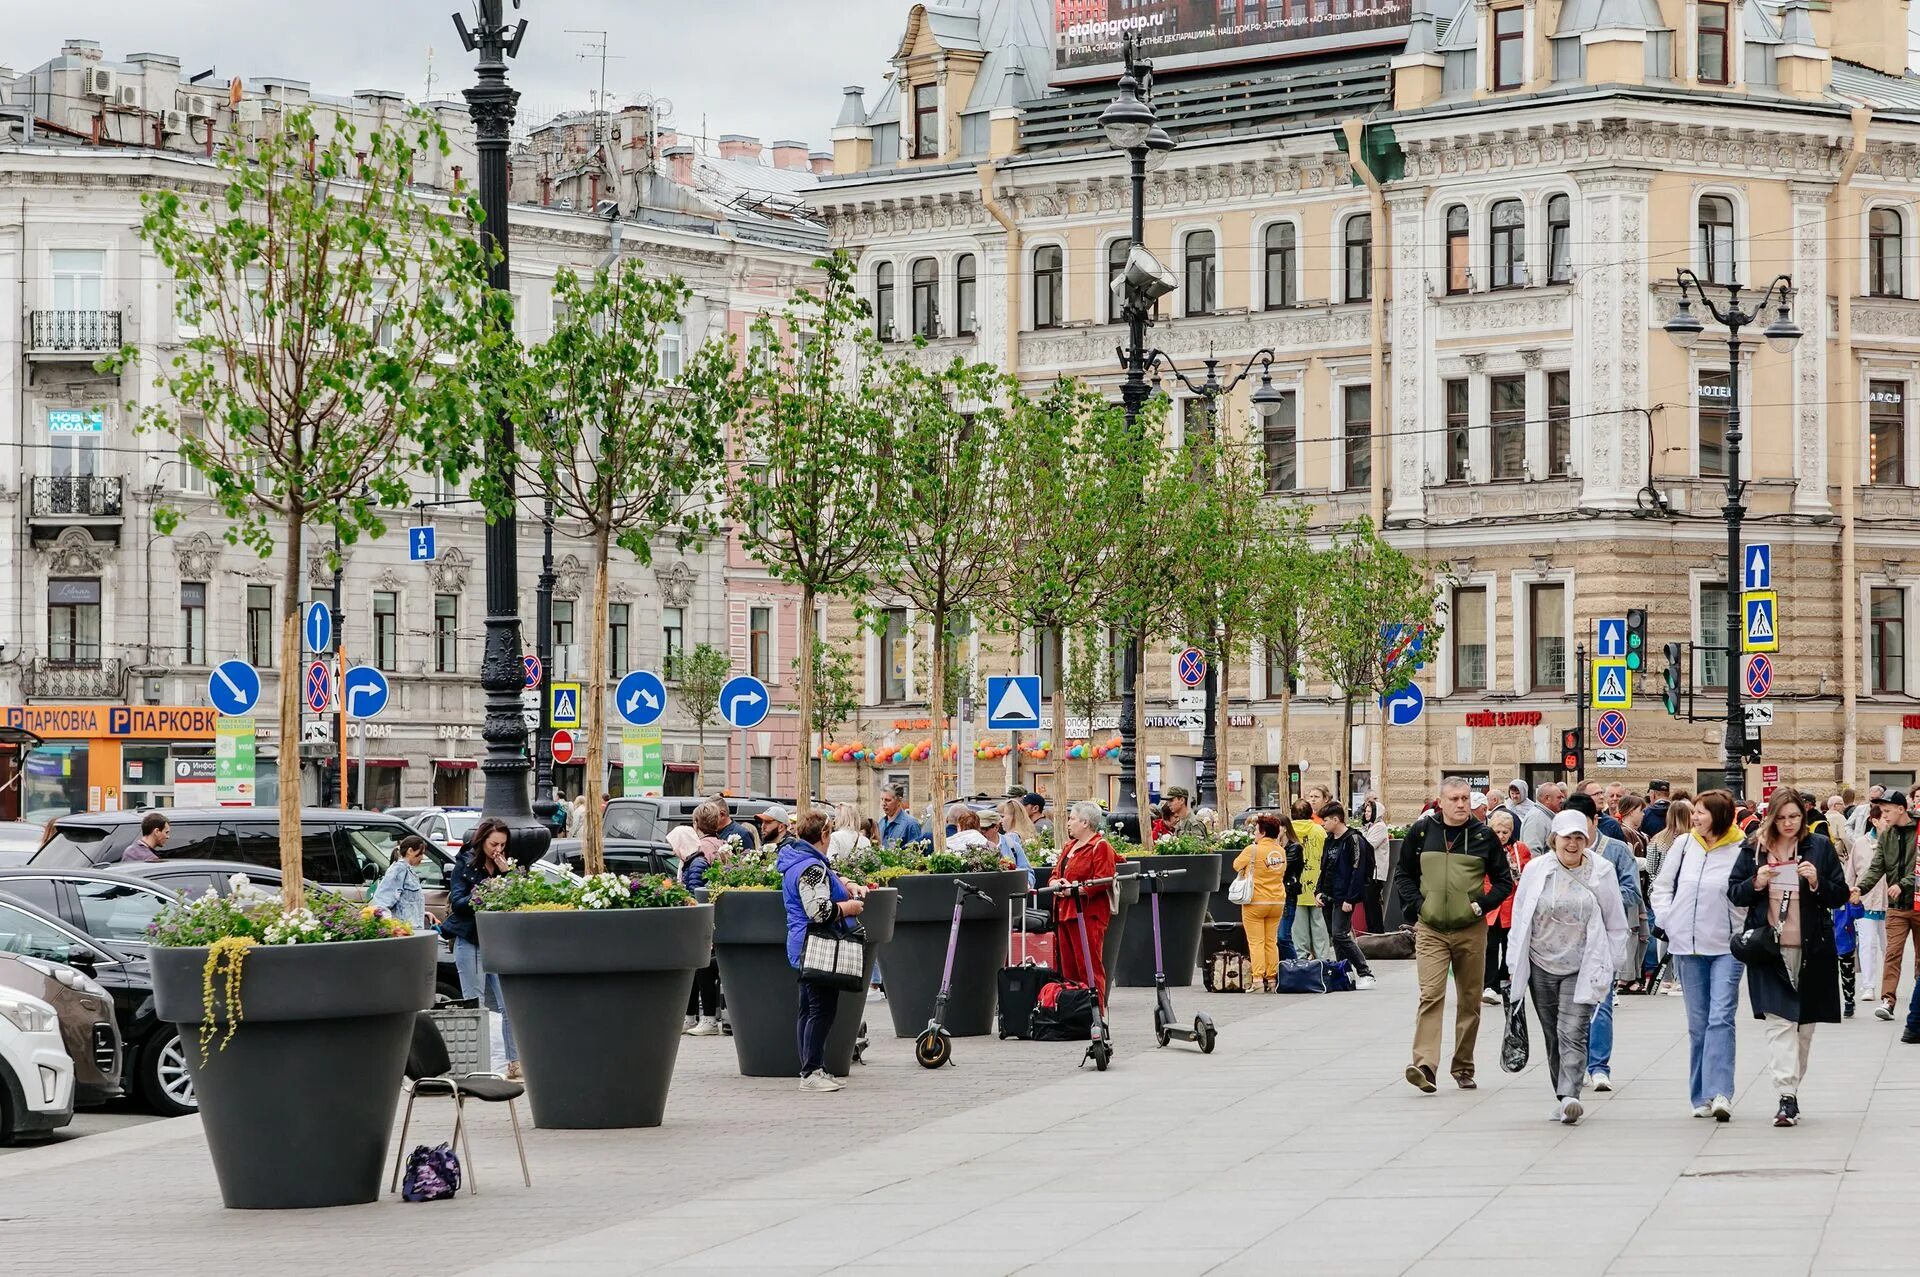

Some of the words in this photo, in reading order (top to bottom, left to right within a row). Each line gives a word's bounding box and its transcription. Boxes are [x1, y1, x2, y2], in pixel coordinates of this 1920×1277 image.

[1069, 13, 1163, 37] etalongroup.ru
[1130, 35, 1163, 48] РОЕКТНЫЕ
[1164, 30, 1205, 44] ДЕКЛАРАЦИИ
[1263, 16, 1308, 30] ЗАСТРОЙЩИК
[50, 422, 93, 431] ЛЮДИ
[1191, 696, 1199, 704] 20
[25, 710, 98, 731] ПАРКОВКА
[133, 711, 219, 732] ПАРКОВК
[1145, 716, 1163, 727] ОЧТА
[1164, 715, 1180, 727] РОСС
[1231, 716, 1252, 726] БАНК
[1466, 709, 1495, 727] СТЕЙК
[1505, 710, 1542, 726] БУРГЕР
[439, 726, 459, 738] БАР
[461, 726, 473, 738] 24
[192, 762, 216, 771] Инфор
